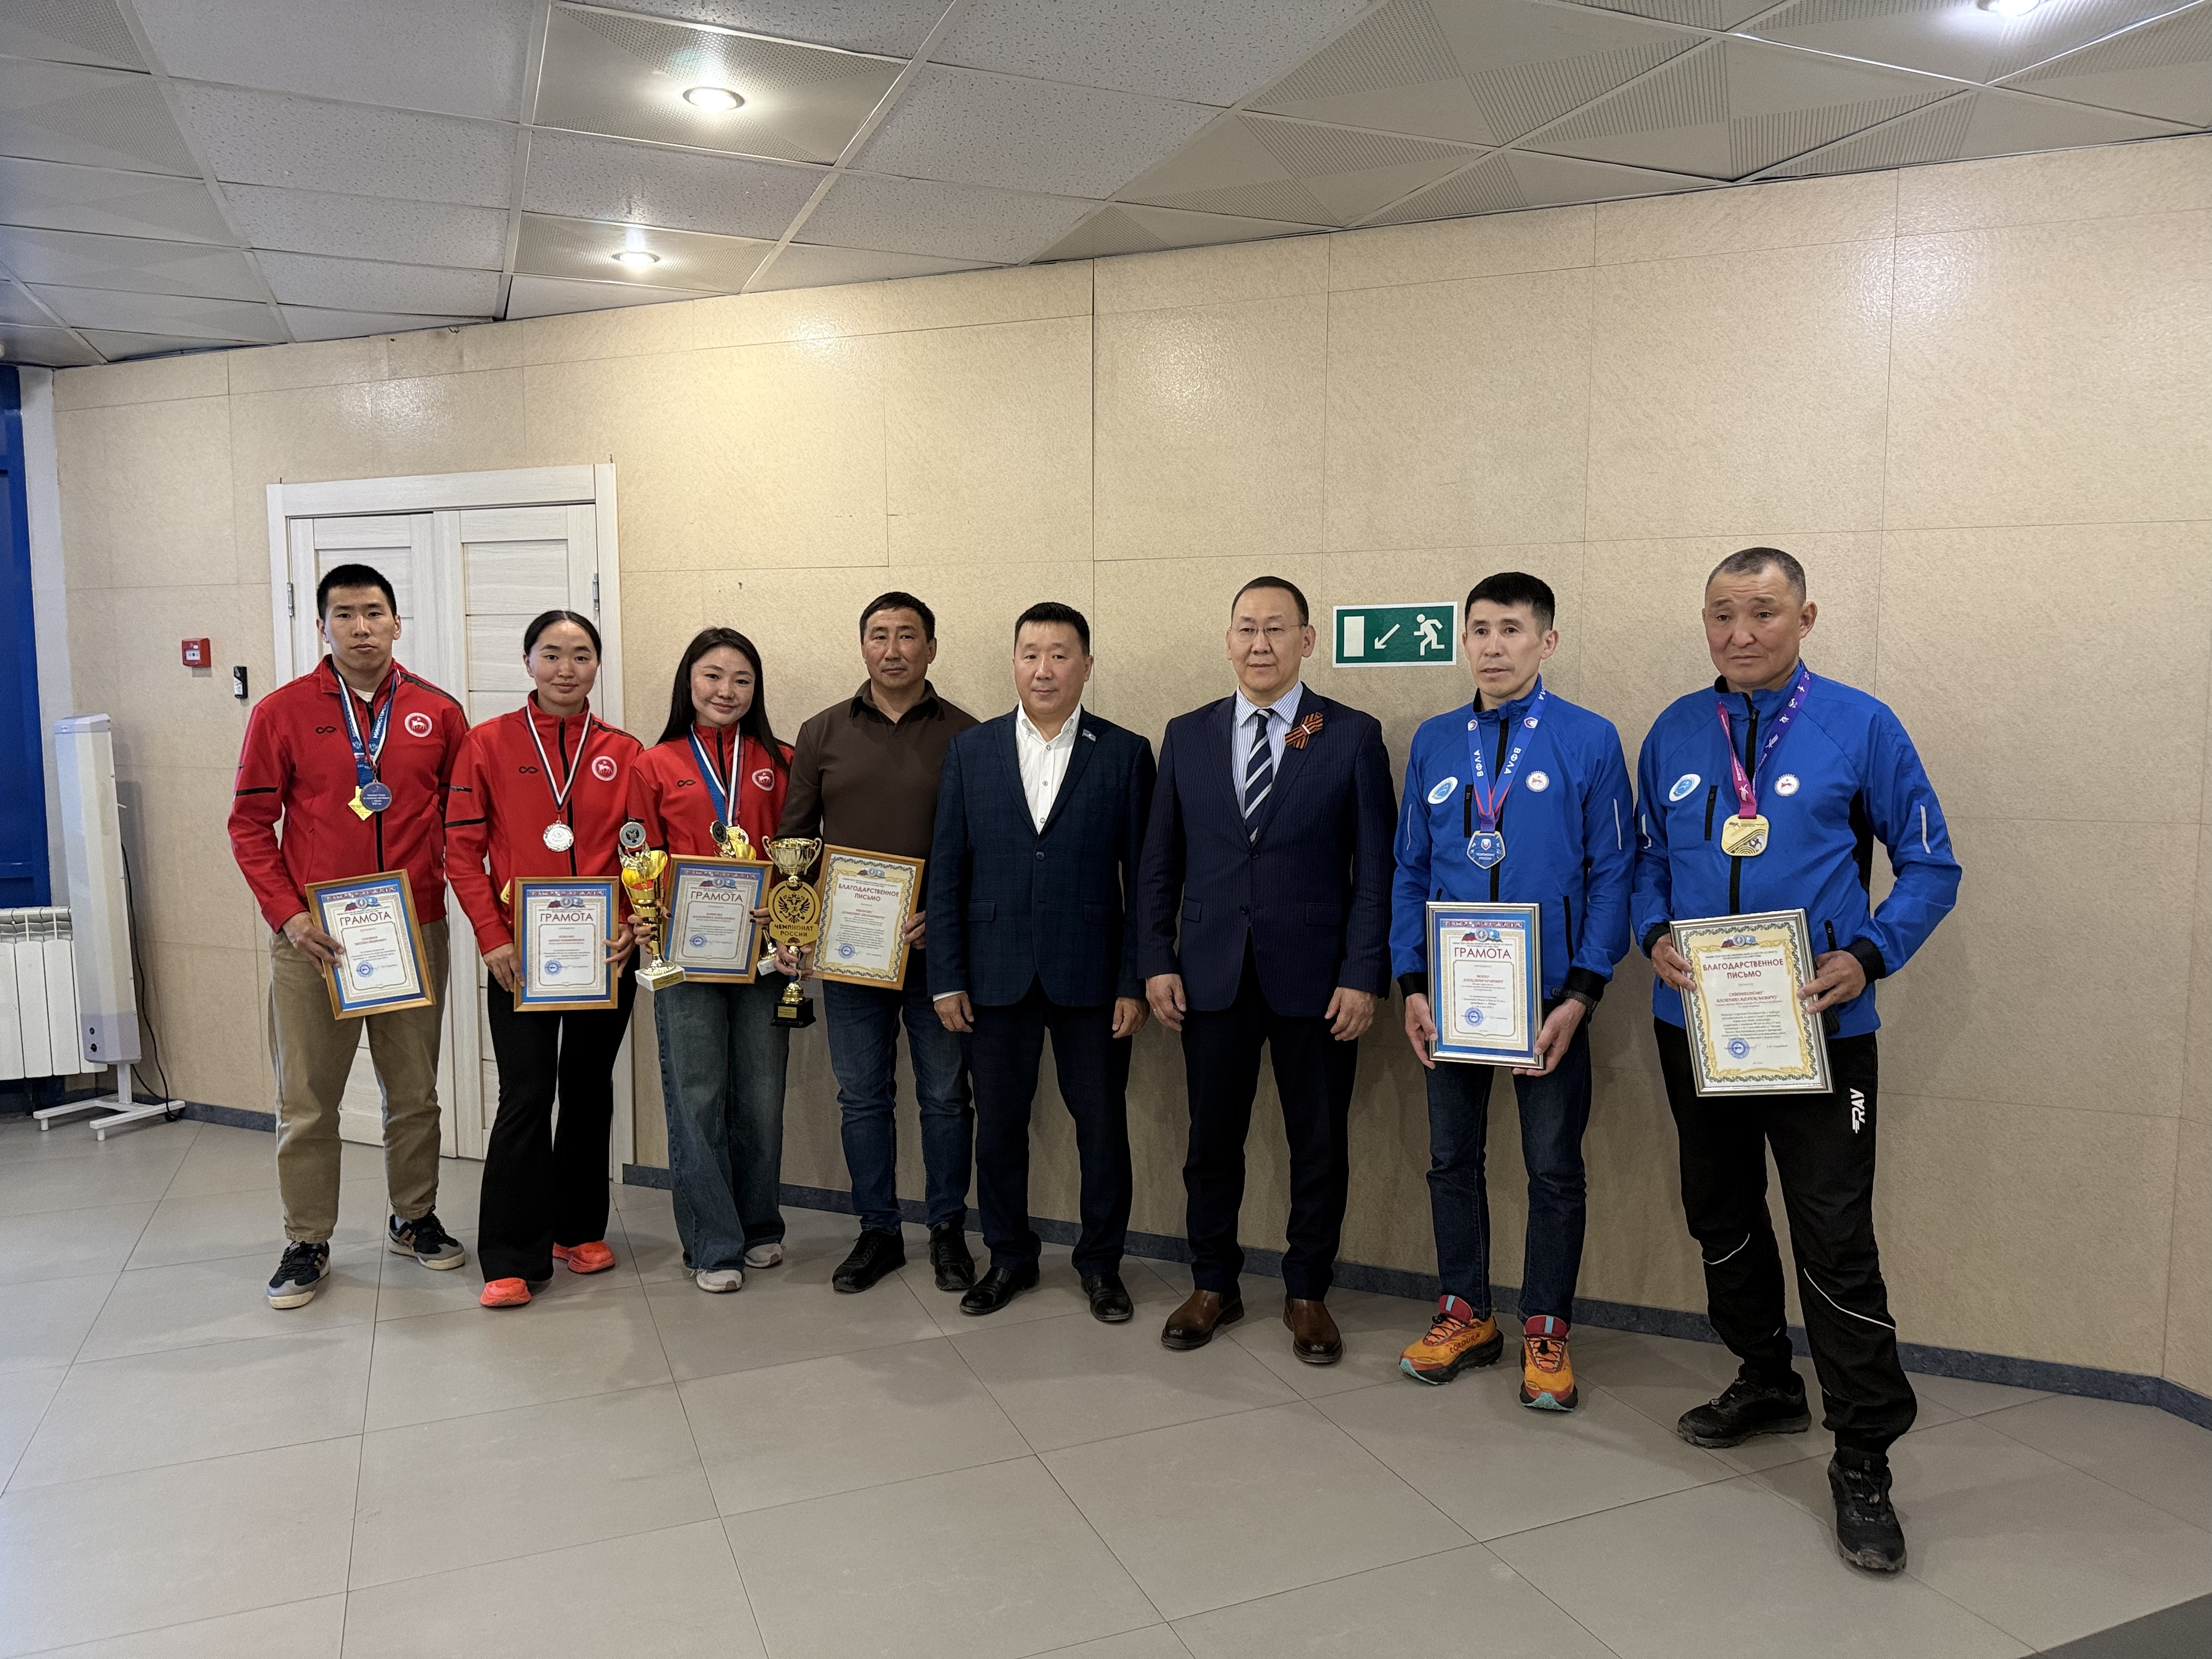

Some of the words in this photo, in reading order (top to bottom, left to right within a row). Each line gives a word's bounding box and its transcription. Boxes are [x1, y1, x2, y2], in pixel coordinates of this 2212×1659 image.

[691, 891, 743, 902] ГРАМОТА
[838, 883, 899, 897] БЛАГОДАРСТВЕННОЕ
[854, 893, 881, 902] ПИСЬМО
[340, 911, 392, 927] ГРАМОТА
[540, 913, 594, 922] ГРАМОТА
[1454, 947, 1512, 960] ГРАМОТА
[1703, 958, 1784, 972] БЛАГОДАРСТВЕННОЕ
[1727, 970, 1762, 979] ПИСЬМО
[1449, 1333, 1480, 1353] CORDURA
